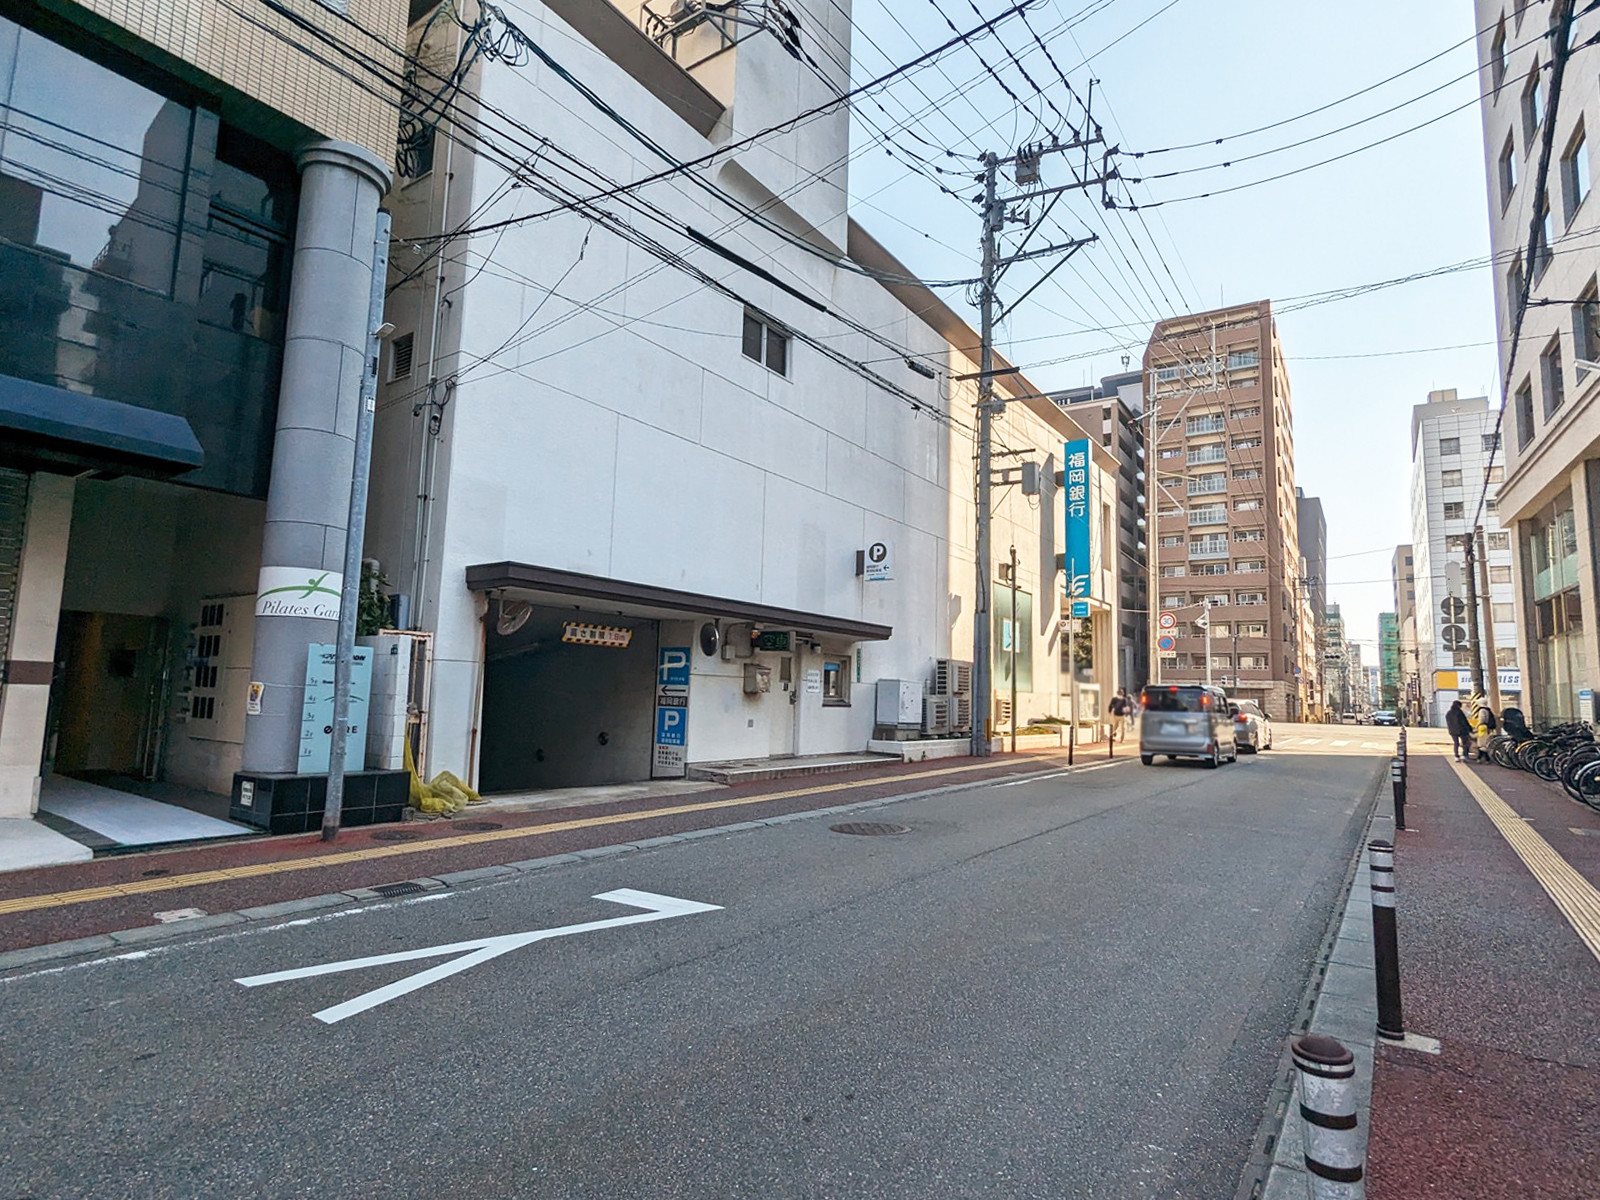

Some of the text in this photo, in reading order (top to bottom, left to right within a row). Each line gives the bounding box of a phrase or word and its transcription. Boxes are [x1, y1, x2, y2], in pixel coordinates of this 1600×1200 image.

[1068, 451, 1086, 518] 福岡銀行
[873, 545, 884, 561] P
[262, 600, 309, 616] Pilates
[1162, 617, 1173, 626] 30
[663, 651, 686, 680] P
[664, 710, 679, 730] P
